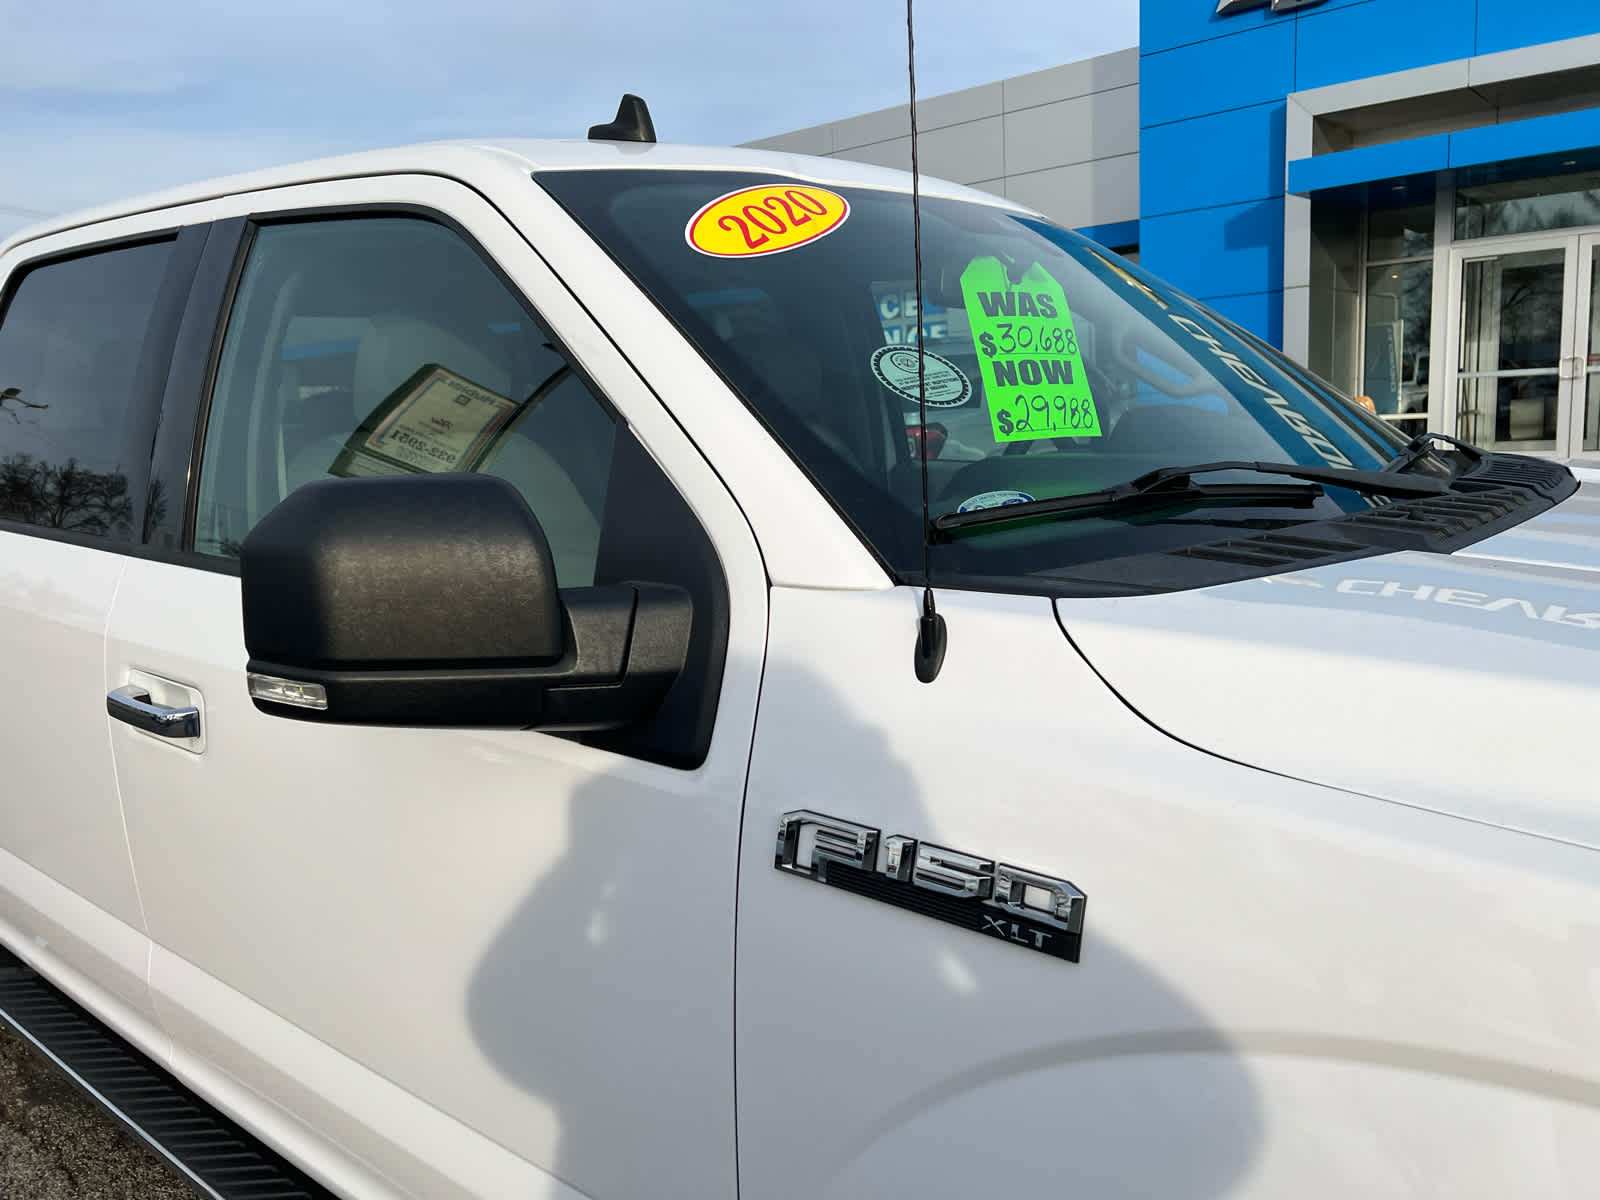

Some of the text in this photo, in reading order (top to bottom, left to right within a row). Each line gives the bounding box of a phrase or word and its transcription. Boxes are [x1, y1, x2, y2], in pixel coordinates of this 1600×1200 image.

[718, 190, 827, 249] 2020
[976, 291, 1058, 318] WAS
[978, 323, 1078, 358] $30,688
[992, 359, 1074, 387] NOW
[996, 394, 1094, 436] $29,988
[982, 914, 1052, 949] XLT
